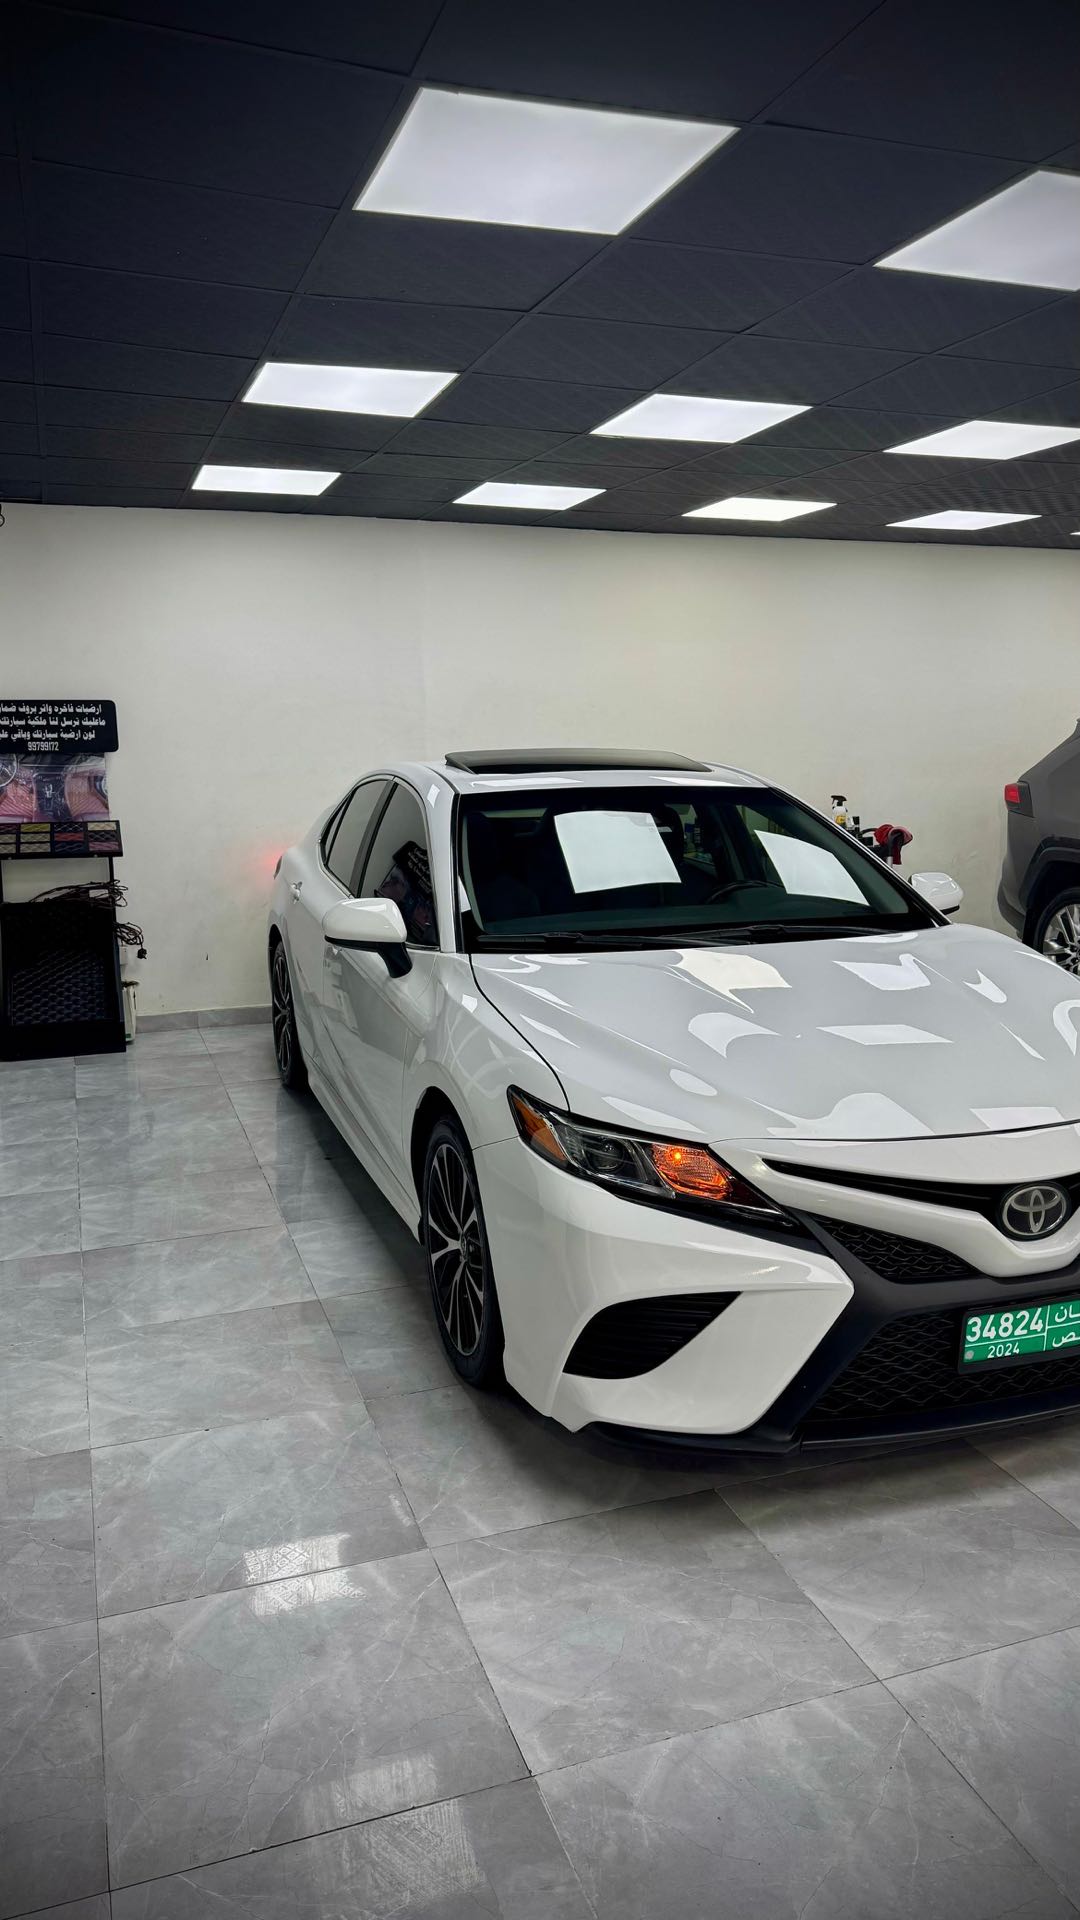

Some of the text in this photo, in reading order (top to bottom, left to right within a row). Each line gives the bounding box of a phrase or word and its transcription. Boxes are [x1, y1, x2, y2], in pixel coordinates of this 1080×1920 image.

[0, 702, 102, 715] ارضيات فاخره واتر بروف ضما
[0, 715, 26, 728] سيارتك
[48, 716, 59, 726] لنا
[60, 716, 80, 728] ترسل
[81, 716, 106, 728] ماعليك
[10, 728, 31, 742] وباقي
[32, 729, 58, 741] سيارتك
[59, 728, 81, 741] ارضية
[82, 729, 96, 741] لون
[27, 741, 60, 751] 99799172
[966, 1307, 1043, 1342] 34824
[987, 1342, 1020, 1359] 2024
